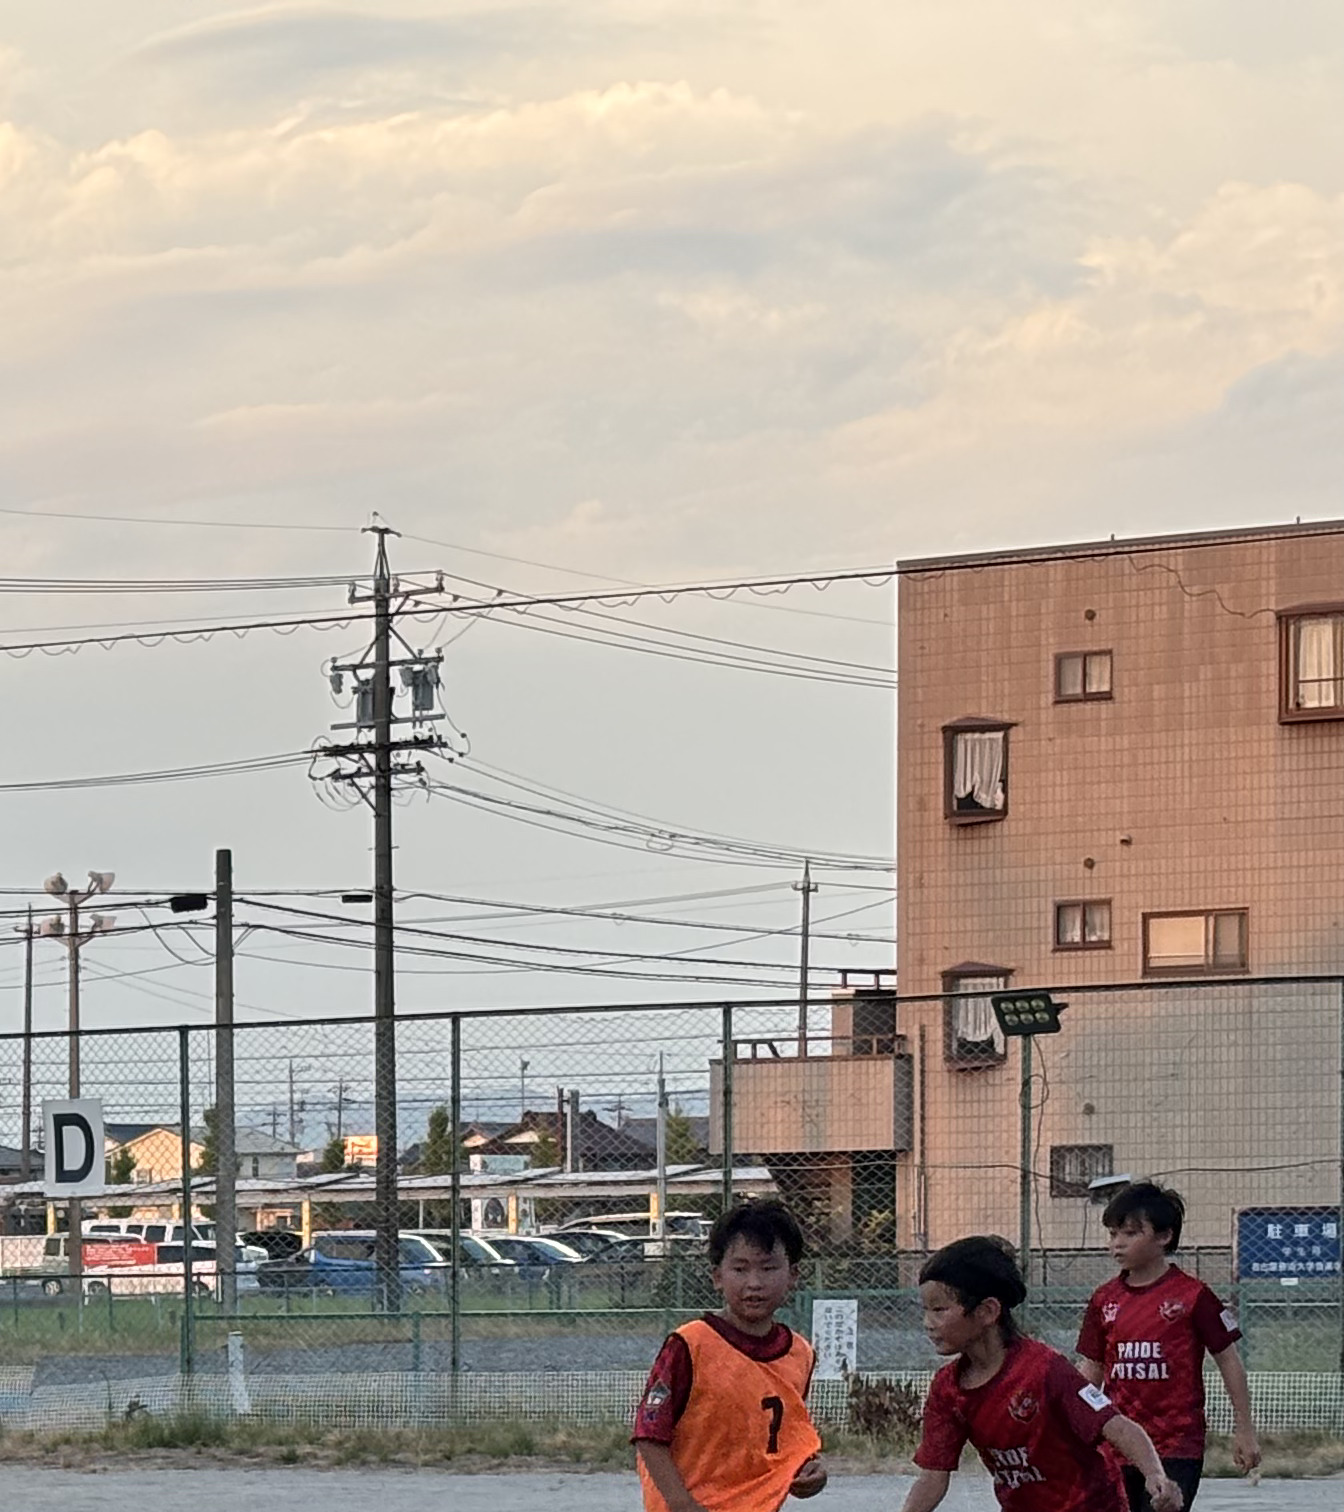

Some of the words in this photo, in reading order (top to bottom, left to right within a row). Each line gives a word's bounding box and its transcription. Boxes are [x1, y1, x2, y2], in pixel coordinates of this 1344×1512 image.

[52, 1113, 95, 1183] D
[1266, 1222, 1337, 1239] 駐車場
[1117, 1341, 1162, 1360] PRIDE
